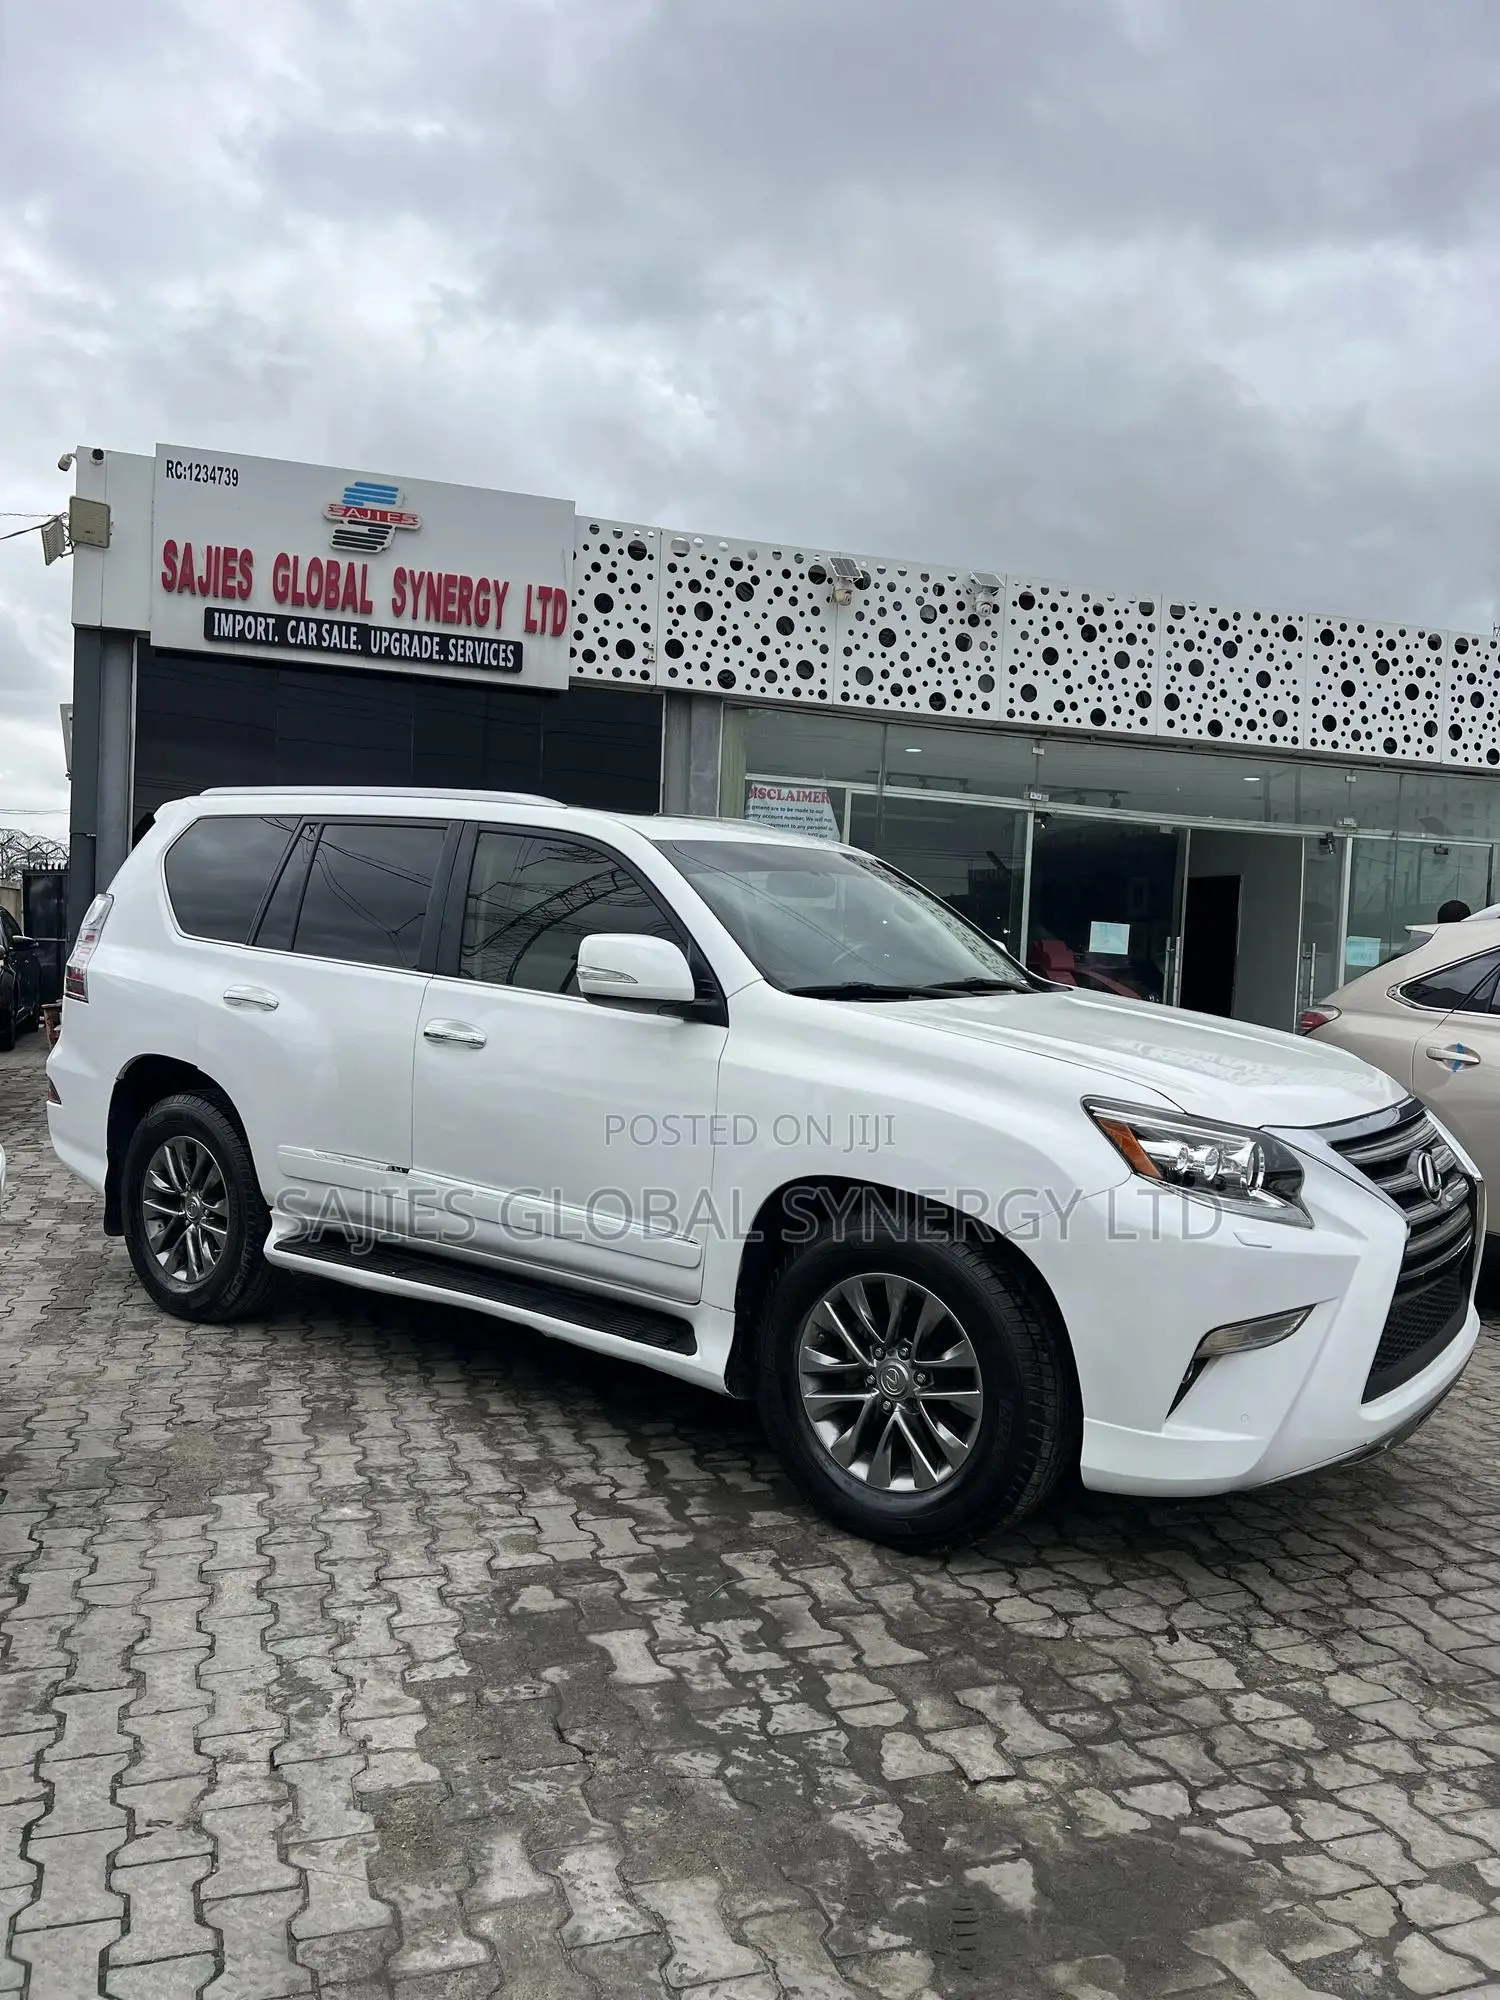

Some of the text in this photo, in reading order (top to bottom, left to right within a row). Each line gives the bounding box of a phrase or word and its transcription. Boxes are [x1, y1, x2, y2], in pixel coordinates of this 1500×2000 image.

[166, 460, 239, 487] RC:1234739
[327, 504, 419, 525] SAJIES
[161, 539, 568, 636] SAJIES GLOBAL SYNERGY LTD
[213, 612, 514, 668] IMPORT. CAR SALE. UPGRADE. SERVICES
